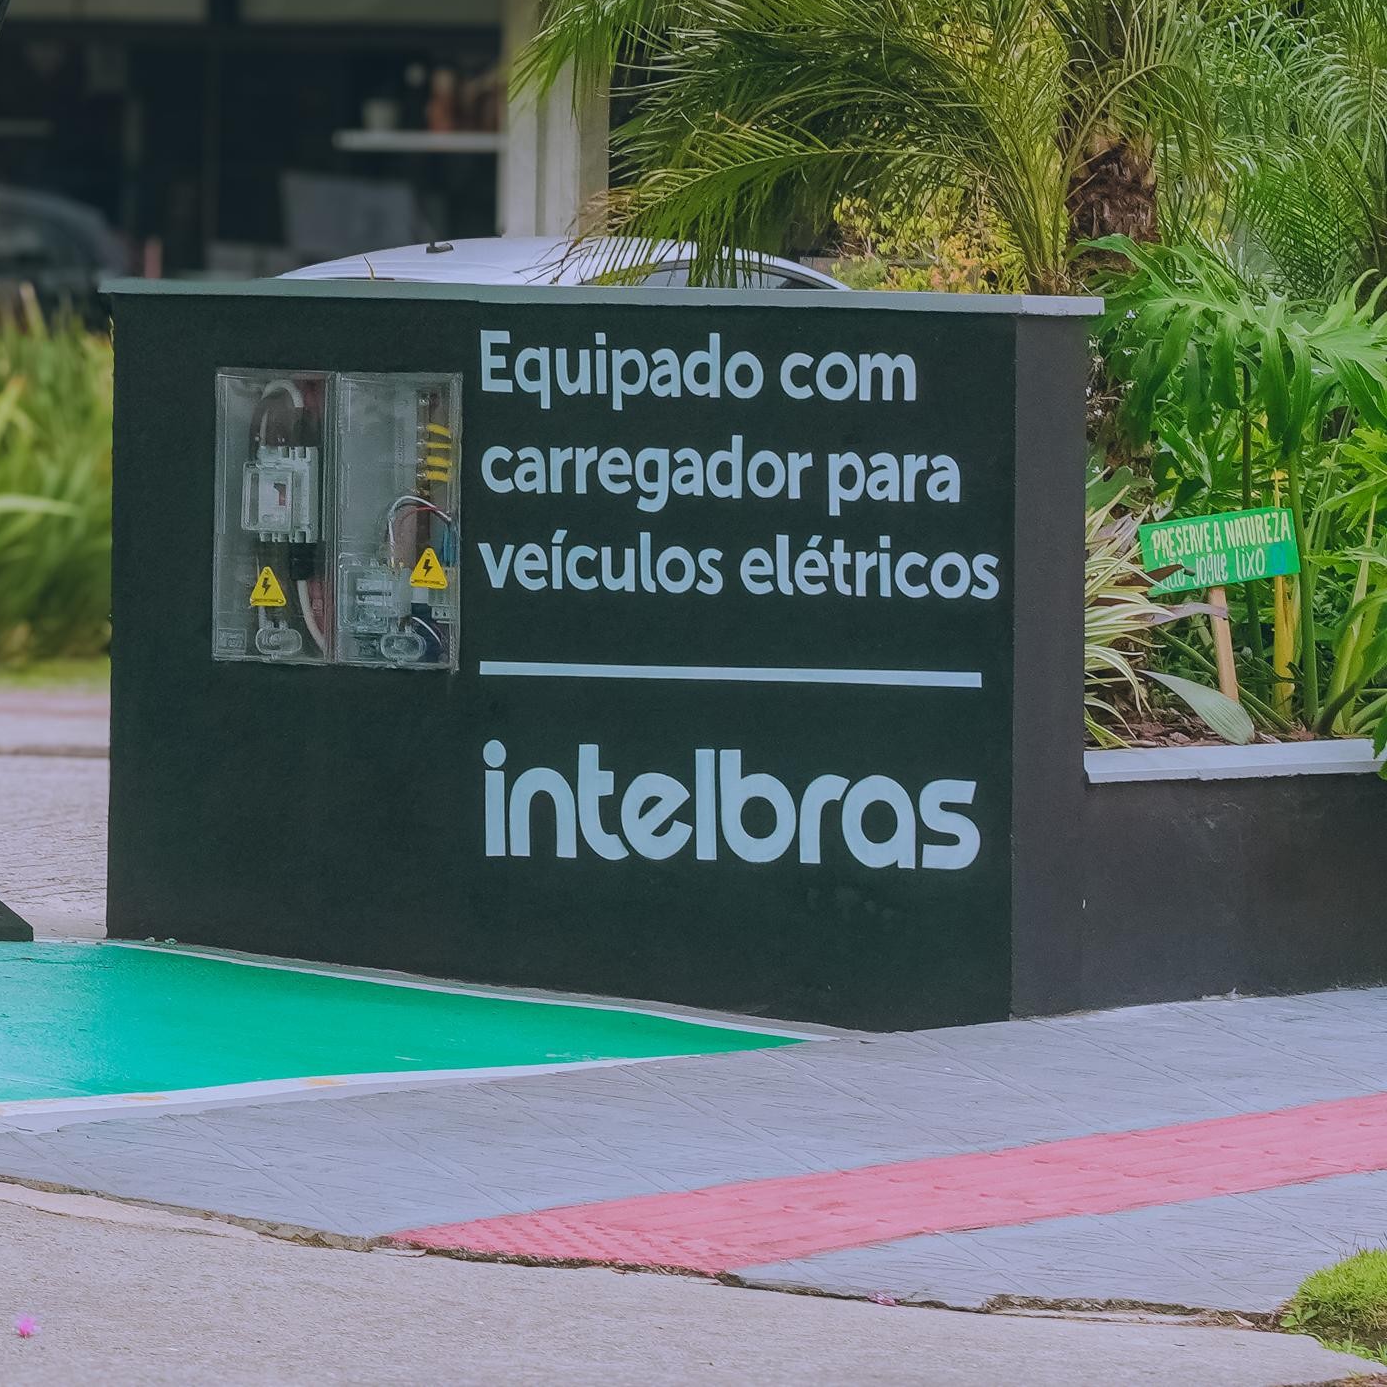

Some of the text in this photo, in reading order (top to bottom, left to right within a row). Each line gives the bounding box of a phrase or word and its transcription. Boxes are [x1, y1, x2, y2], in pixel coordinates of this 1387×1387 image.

[479, 328, 918, 412] Equipado com
[480, 433, 814, 514] carregador
[827, 450, 962, 517] para
[477, 528, 1001, 601] veículos elétricos
[1151, 511, 1292, 560] PRESERVE A NATUREZA
[1192, 552, 1229, 587] jogue
[482, 738, 982, 871] intelbras
